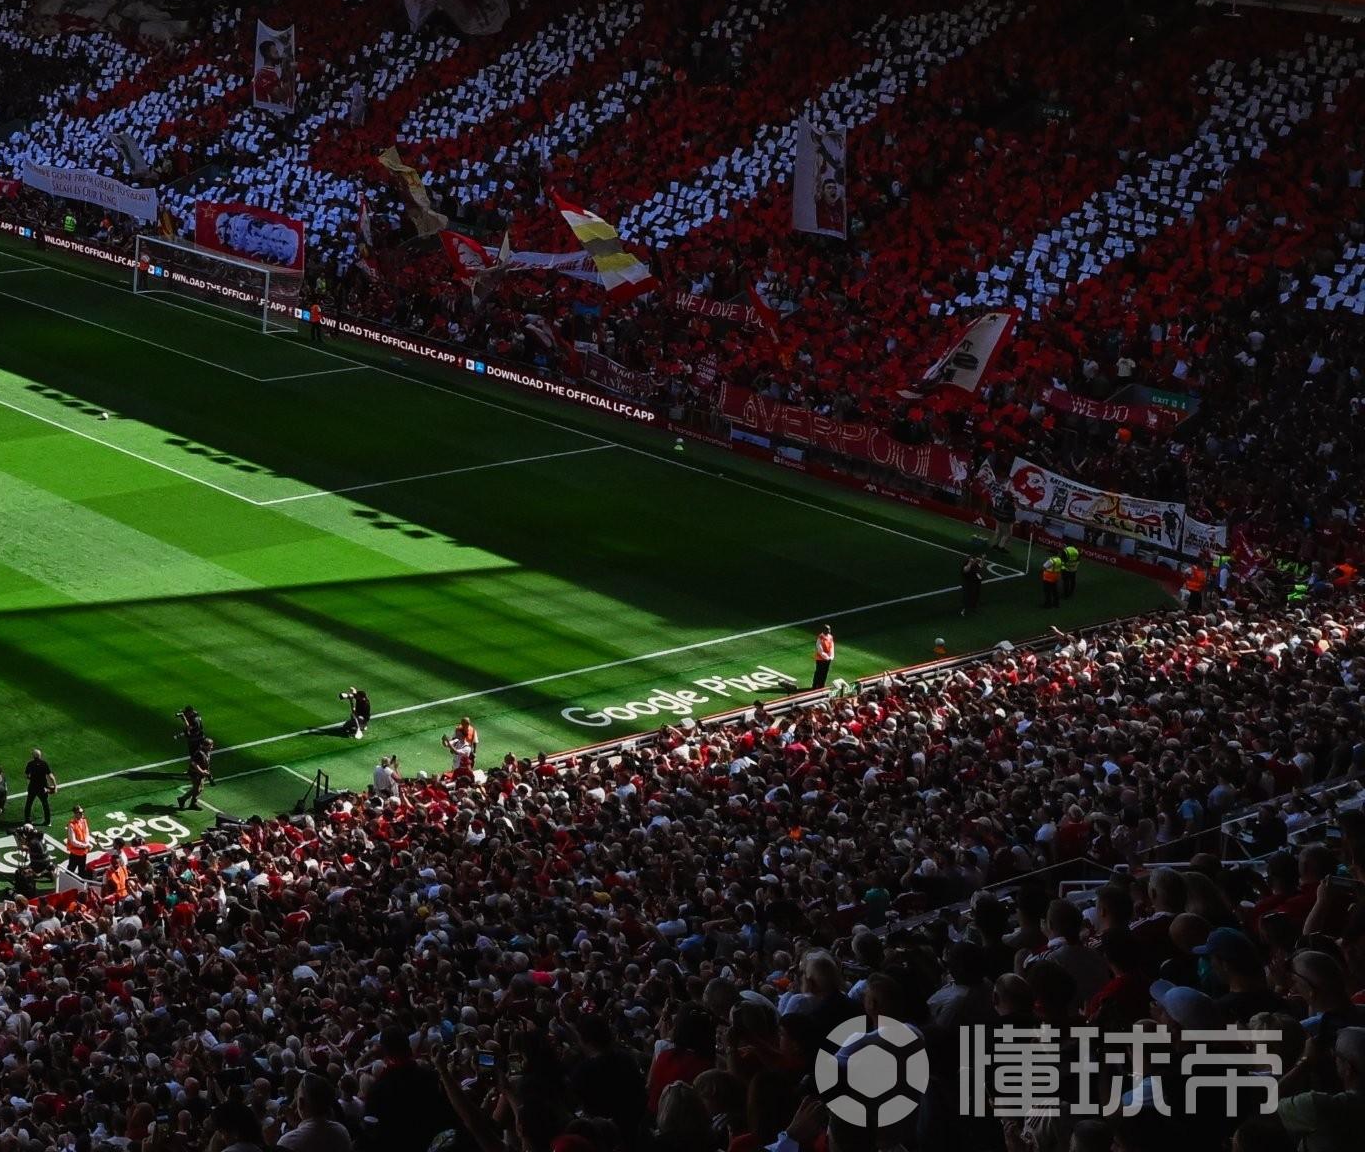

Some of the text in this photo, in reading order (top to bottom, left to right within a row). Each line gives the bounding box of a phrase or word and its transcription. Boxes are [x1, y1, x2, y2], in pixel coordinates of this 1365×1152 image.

[0, 220, 13, 231] APP
[70, 241, 84, 253] THE
[84, 246, 114, 262] OFFICIAL
[114, 253, 127, 265] LFC
[270, 301, 287, 313] APP
[675, 292, 701, 312] WE
[700, 298, 741, 321] LOVE
[319, 317, 456, 364] OWLOAD THE OFFICIAL LFC APP
[487, 365, 655, 422] DOWNLOAD THE OFFICIAL LFC APP
[561, 665, 798, 727] Google Pixel
